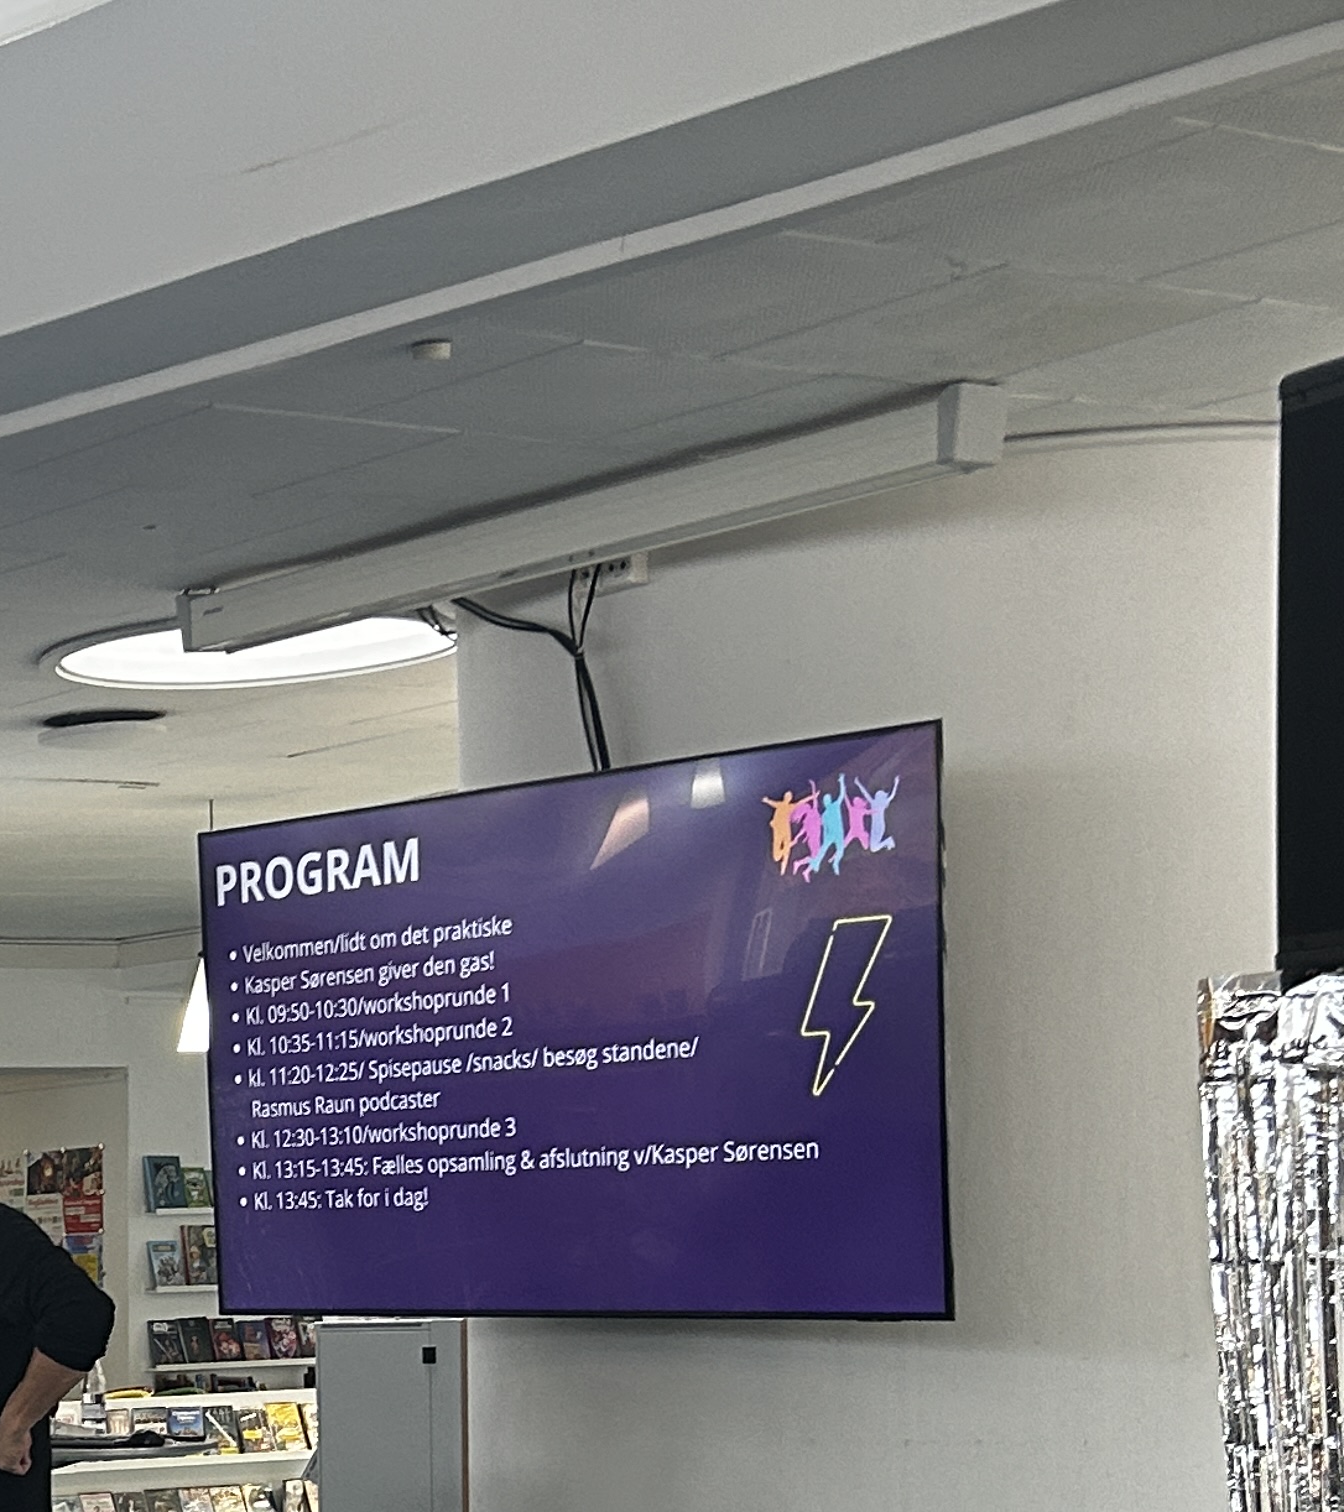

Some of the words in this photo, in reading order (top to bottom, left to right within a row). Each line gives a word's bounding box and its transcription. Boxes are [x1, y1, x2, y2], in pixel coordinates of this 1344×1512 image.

[215, 836, 419, 907] PROGRAM
[242, 930, 367, 963] Velkommen/lidt
[369, 931, 397, 950] om
[400, 923, 430, 946] det
[432, 914, 513, 948] praktiske
[244, 973, 297, 998] Kasper
[300, 966, 375, 990] Sørensen
[378, 959, 420, 987] giver
[422, 954, 456, 977] den
[459, 949, 495, 979] gas!
[245, 1004, 265, 1025] Kl.
[267, 982, 497, 1024] 09:50-10:30/workshoprunde
[500, 981, 510, 1003] 1
[247, 1036, 266, 1057] Kl.
[269, 1016, 499, 1055] 10:35-11:15/workshoprunde
[500, 1015, 513, 1037] 2
[269, 1060, 366, 1086] 11:20-12:25/
[368, 1056, 463, 1084] Spisepause
[465, 1047, 539, 1073] /snacks/
[542, 1045, 599, 1071] besøg
[601, 1036, 700, 1064] standene/
[251, 1099, 312, 1118] Rasmus
[314, 1095, 355, 1115] Raun
[359, 1089, 442, 1118] podcaster
[251, 1129, 271, 1149] Kl.
[273, 1116, 502, 1148] 12:30-13:10/workshoprunde
[504, 1116, 517, 1138] 3
[252, 1160, 272, 1180] Kl.
[274, 1156, 369, 1179] 13:15-13:45:
[372, 1153, 424, 1176] Fælles
[427, 1149, 517, 1179] opsamling
[520, 1149, 535, 1170] &
[538, 1145, 631, 1172] afslutning
[633, 1143, 720, 1170] v/Kasper
[723, 1140, 820, 1163] Sørensen
[253, 1191, 273, 1211] Kl.
[275, 1190, 323, 1210] 13:45:
[324, 1188, 354, 1209] Tak
[356, 1187, 381, 1209] for
[384, 1187, 390, 1208] i
[392, 1186, 429, 1212] dag!
